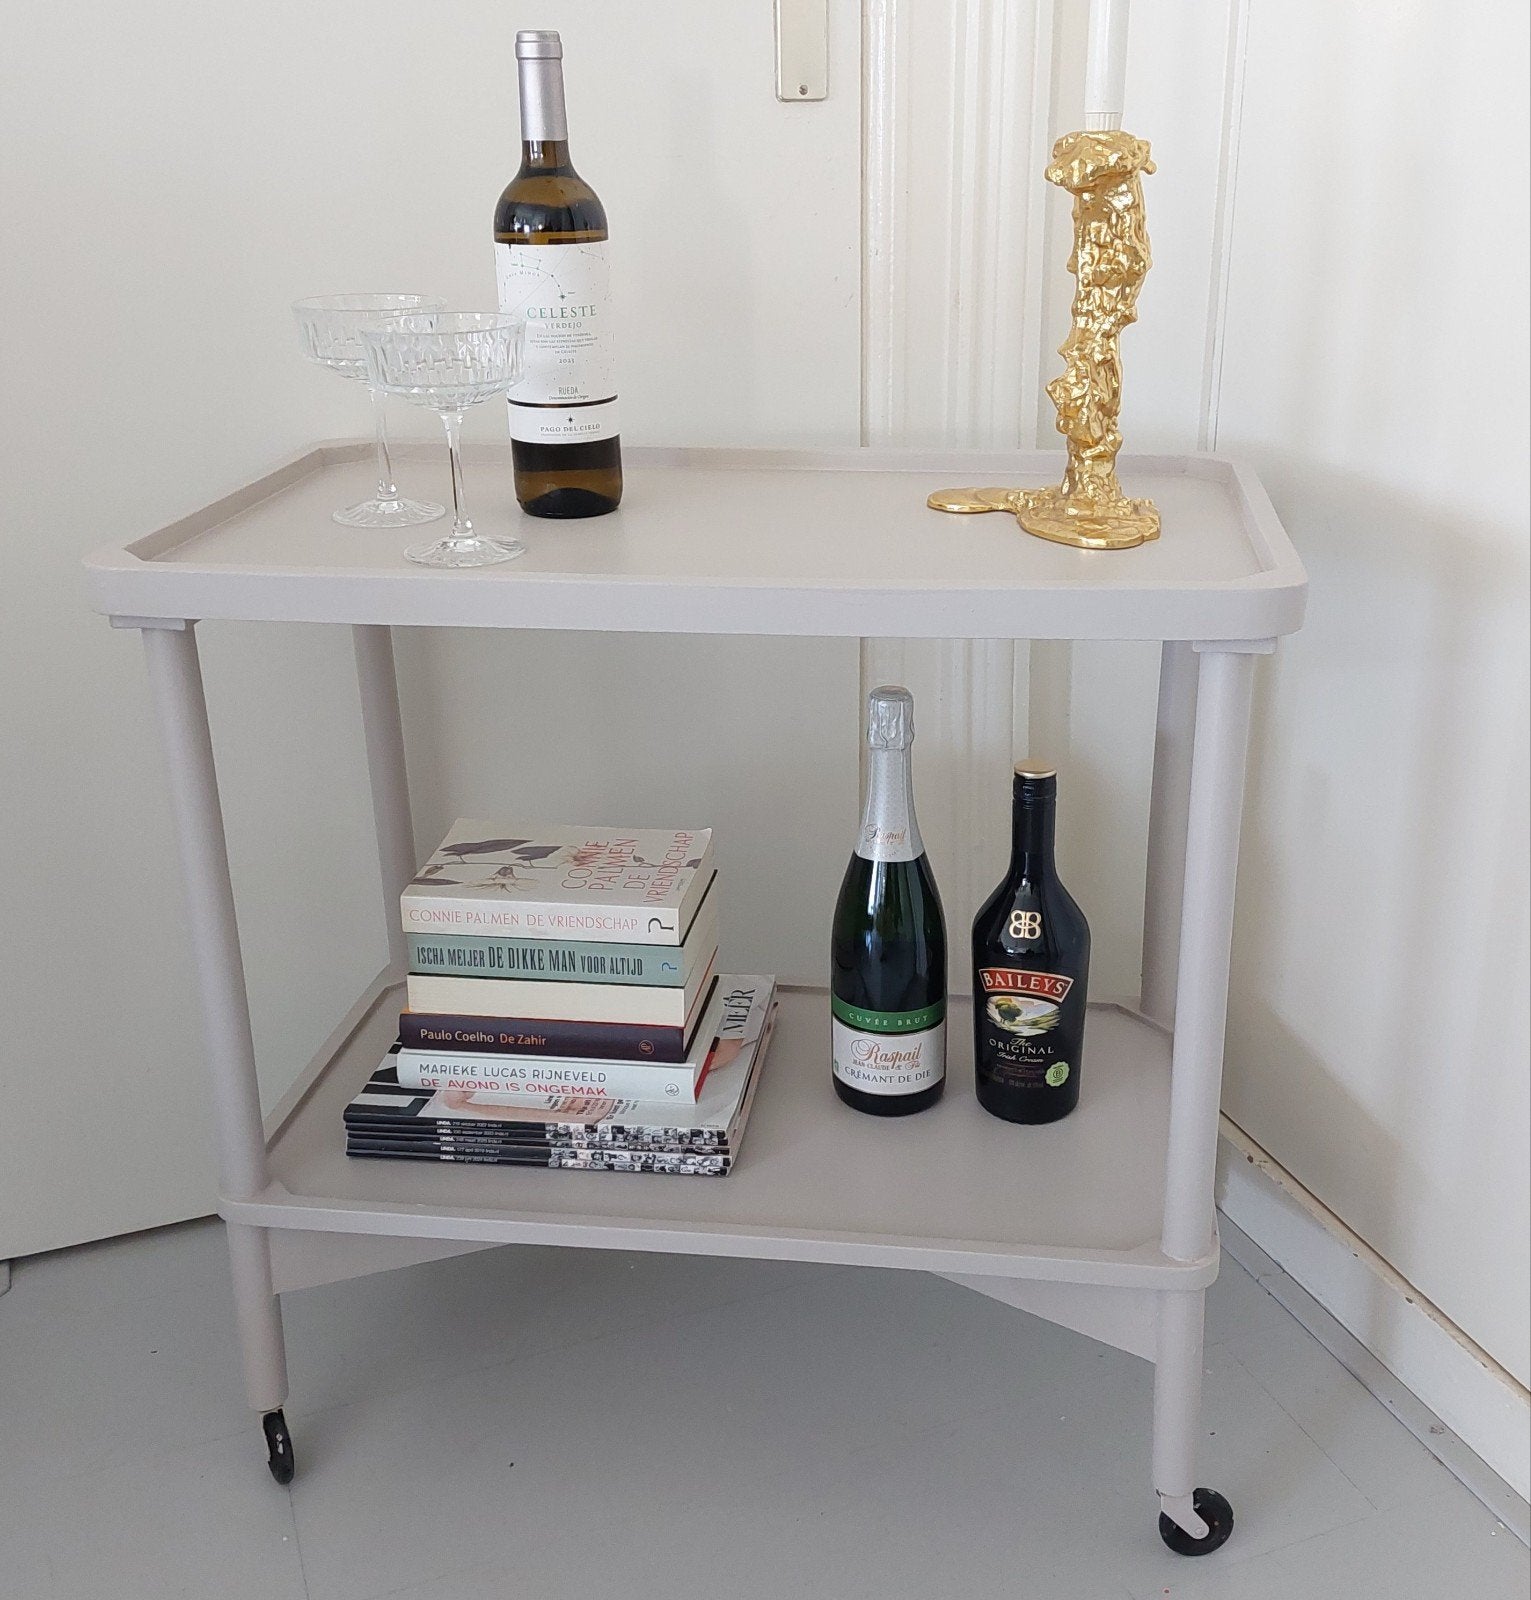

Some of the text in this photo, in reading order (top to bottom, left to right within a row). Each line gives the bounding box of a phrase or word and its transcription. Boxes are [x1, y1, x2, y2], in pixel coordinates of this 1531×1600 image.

[527, 304, 597, 319] CELESTE
[545, 322, 582, 330] VERDEJO
[558, 386, 579, 395] RUEDA
[579, 423, 601, 431] CIELO
[561, 841, 609, 889] CONNIE
[588, 838, 639, 890] PALMEN
[643, 832, 694, 903] VRIENDSCHAP
[623, 874, 651, 890] DE
[409, 909, 638, 930] CONNIE PALMEN DE VRIENDSCHAP
[416, 946, 643, 976] ISCHA MEIJER DE DIKKE MAN VOOR ALTIJD
[983, 972, 1065, 994] BAILEYS
[848, 1012, 928, 1026] CUVÉE BRUT
[420, 1029, 547, 1045] Paulo Coelho De Zahir
[1010, 1037, 1032, 1047] The
[850, 1039, 923, 1069] Raspail
[988, 1038, 1055, 1055] ORIGINAL
[419, 1063, 607, 1083] MARIEKE LUCAS RIJNEVELD
[844, 1066, 931, 1083] CRÉMANT DE DIE
[420, 1078, 608, 1096] DE AVOND IS ONGEMAK
